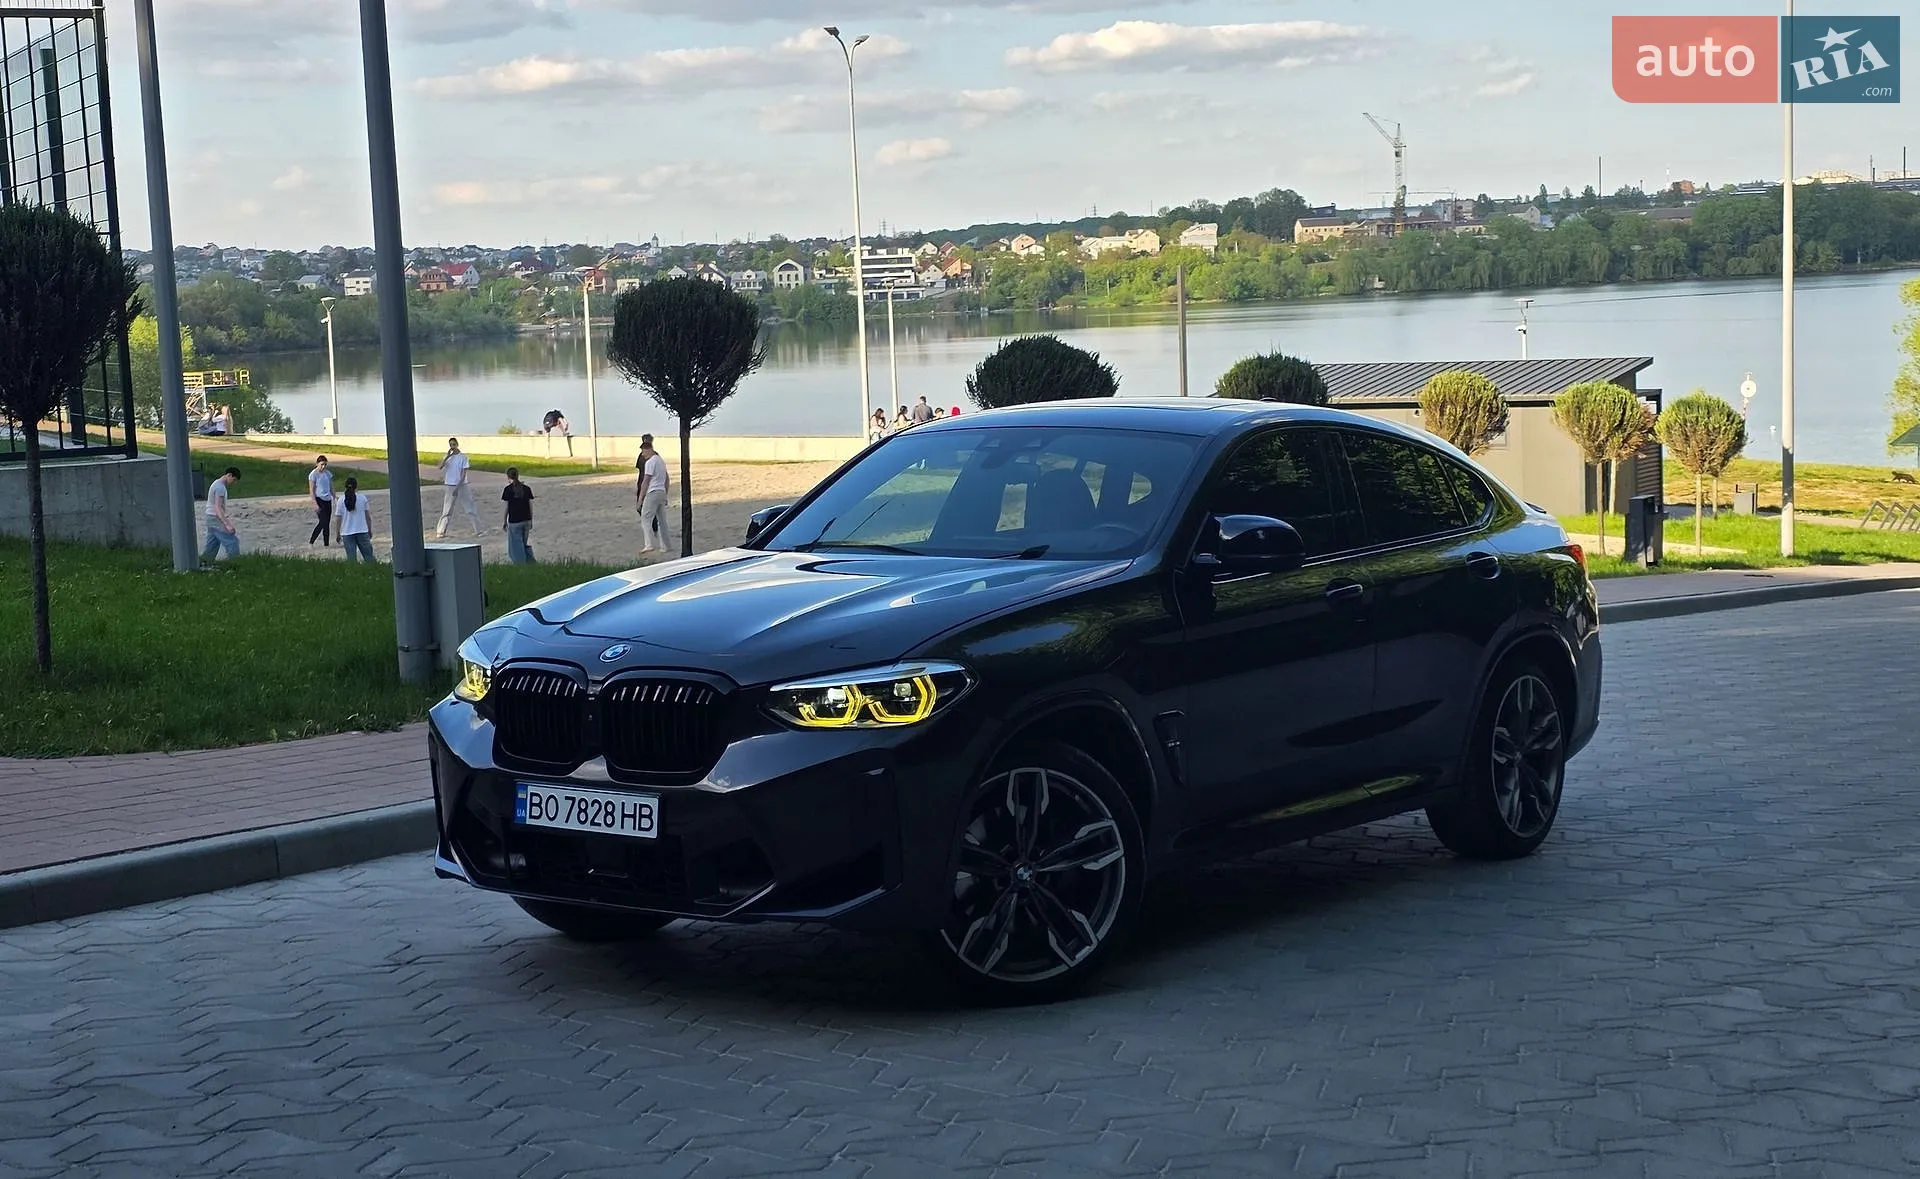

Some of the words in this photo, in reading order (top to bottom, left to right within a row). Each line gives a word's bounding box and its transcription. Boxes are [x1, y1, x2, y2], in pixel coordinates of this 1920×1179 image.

[516, 809, 526, 818] UA
[528, 791, 559, 822] BO
[564, 795, 616, 828] 7828
[620, 801, 654, 832] HB
